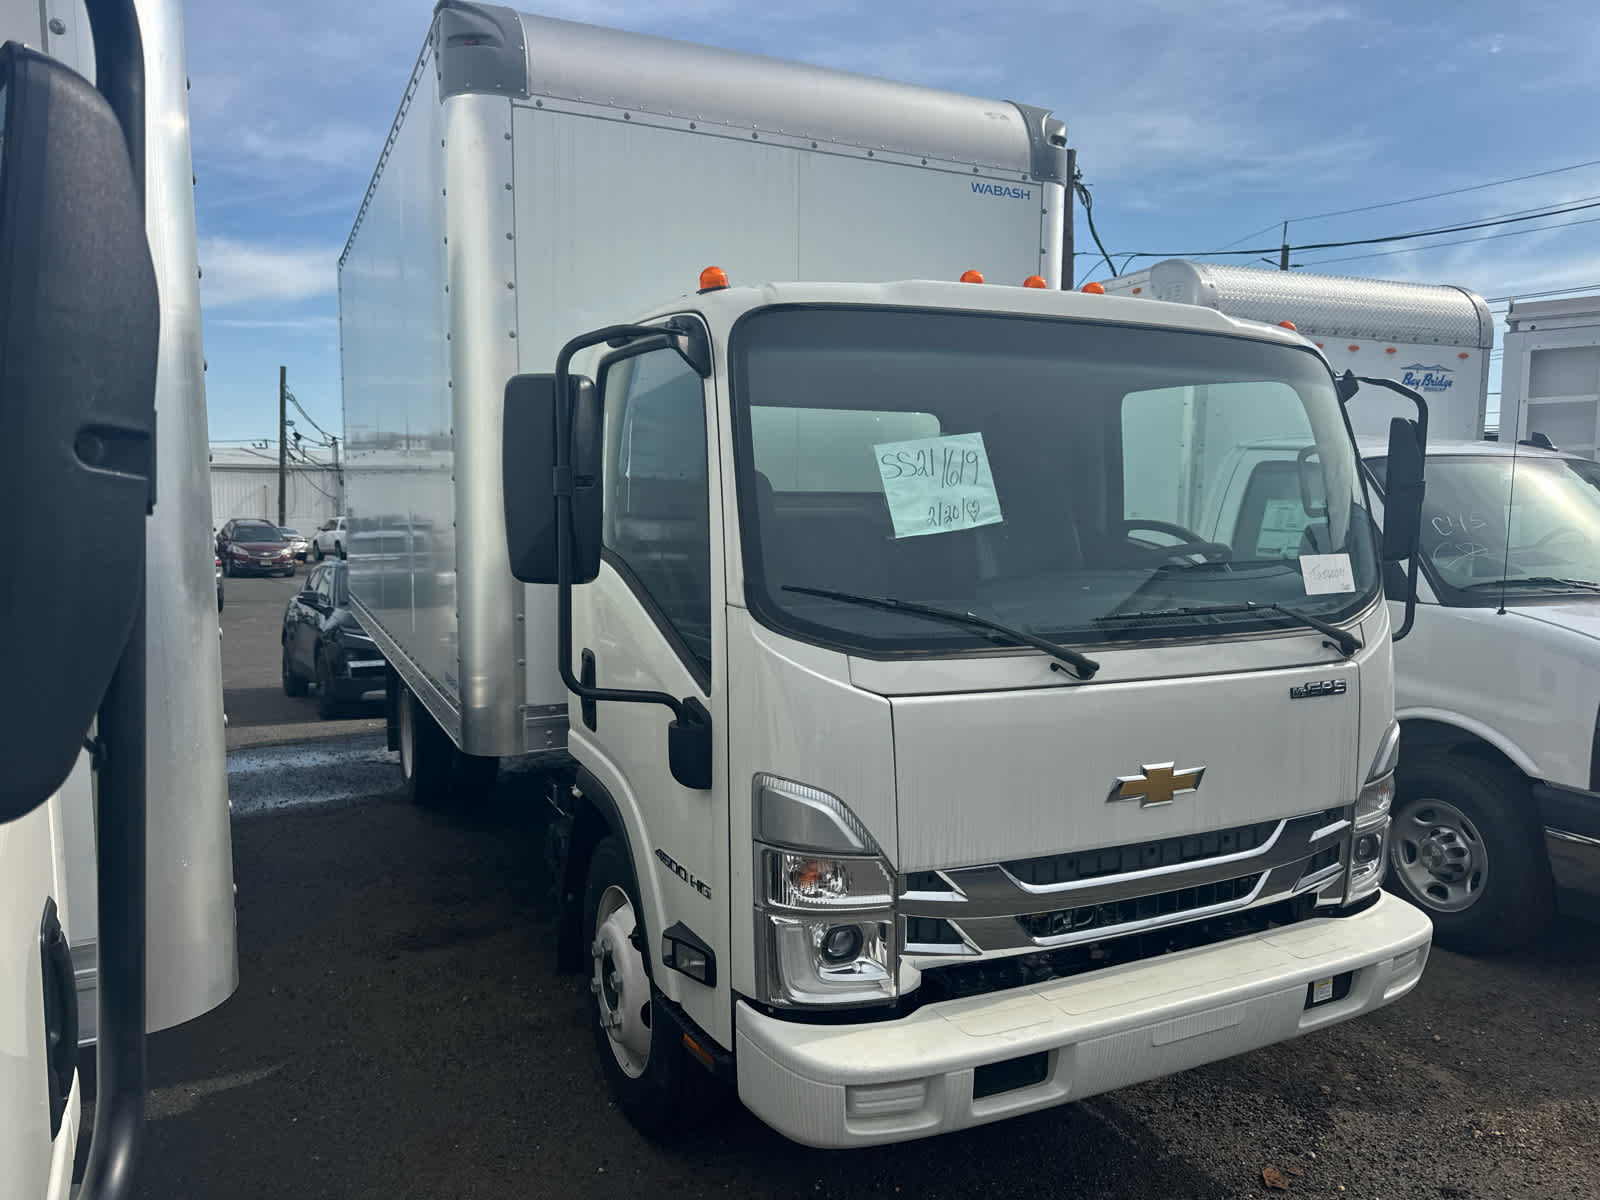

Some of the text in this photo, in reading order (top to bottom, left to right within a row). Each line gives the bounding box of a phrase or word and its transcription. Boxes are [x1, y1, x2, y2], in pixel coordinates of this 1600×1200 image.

[970, 182, 1031, 200] WABASH
[1401, 371, 1454, 391] Bay Bridge
